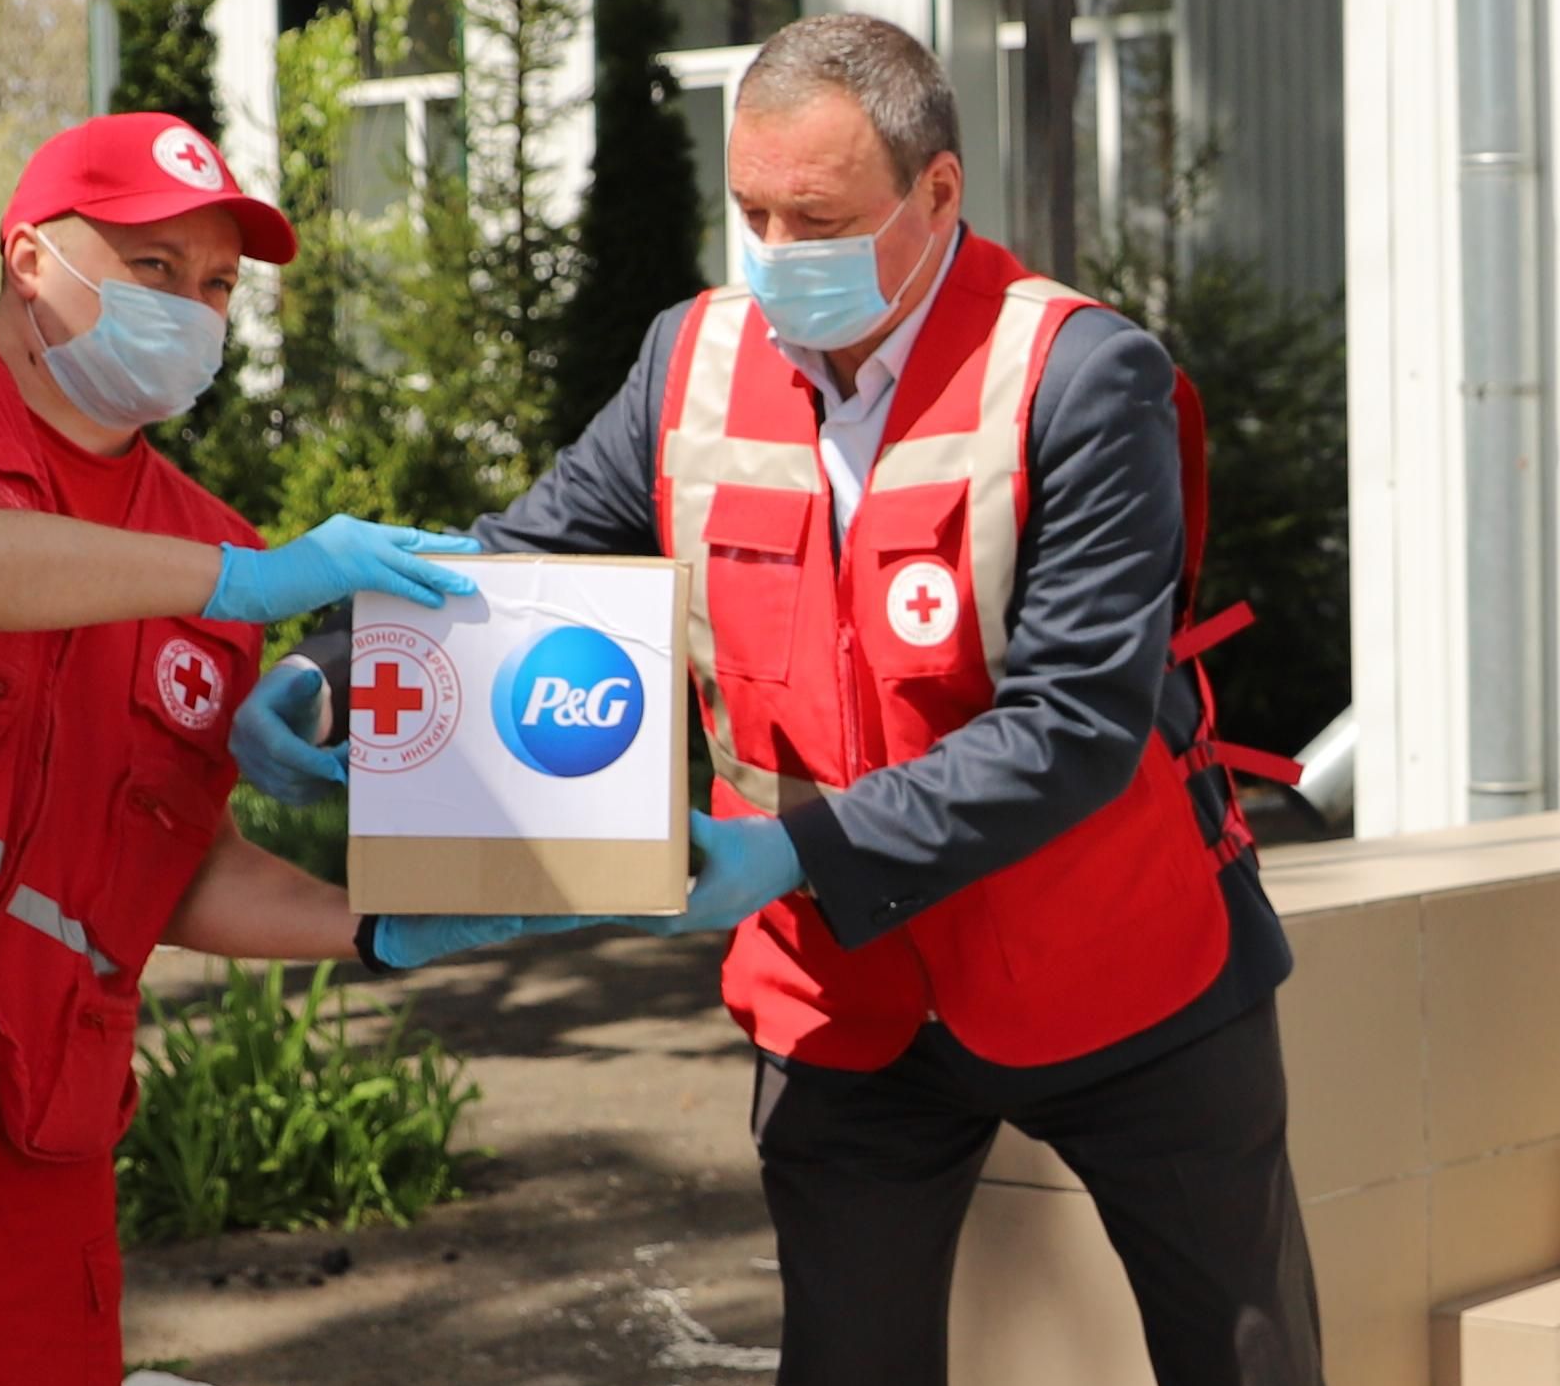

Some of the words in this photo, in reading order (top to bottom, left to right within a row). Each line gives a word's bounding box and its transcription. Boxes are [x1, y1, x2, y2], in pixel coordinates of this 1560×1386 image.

[352, 631, 417, 649] ВОНОГО
[423, 648, 454, 703] ХРЕСТА
[521, 676, 631, 727] P&G
[400, 714, 452, 762] УКРАЇНИ
